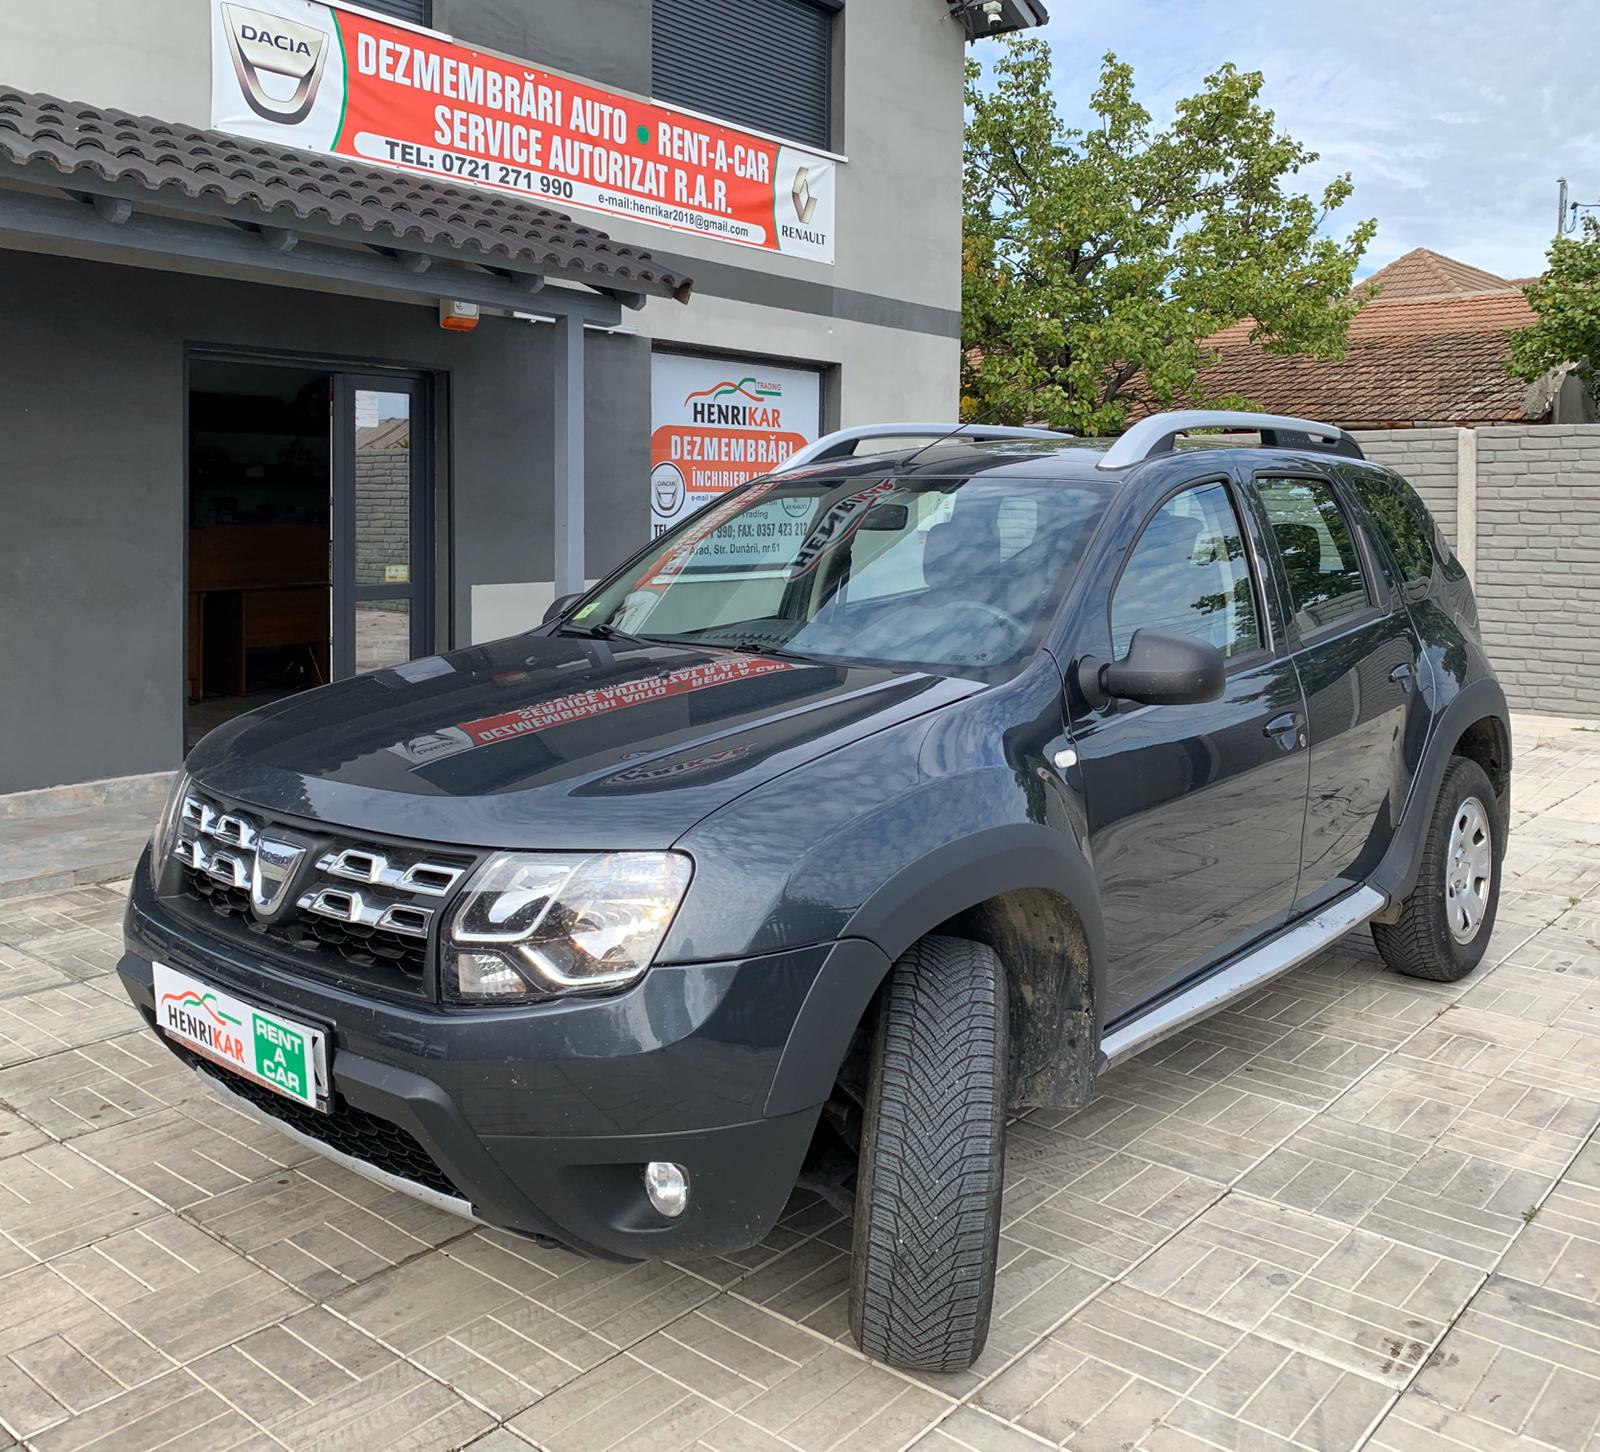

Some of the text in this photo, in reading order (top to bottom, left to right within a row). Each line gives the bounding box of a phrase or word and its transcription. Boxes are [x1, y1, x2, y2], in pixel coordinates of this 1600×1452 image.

[241, 24, 311, 57] DACIA
[358, 32, 769, 185] DEZMEMBRĂRI AUTO RENT-A-CAR
[385, 140, 573, 199] TEL: 0721 271 990
[434, 104, 732, 214] SERVICE AUTORIZAT R.A.R.
[598, 193, 749, 237] e-mail:henrikar2018@gmail.com
[781, 224, 827, 246] RENAULT
[757, 381, 782, 391] TRADING
[693, 402, 782, 428] HENRIKAR
[738, 524, 755, 537] FAX:
[756, 523, 775, 537] 0357
[778, 523, 792, 536] 423
[714, 544, 728, 555] Str.
[168, 1004, 245, 1065] HENRIKAR
[255, 1021, 302, 1055] RENT
[273, 1047, 287, 1068] A
[263, 1058, 300, 1093] CAR
